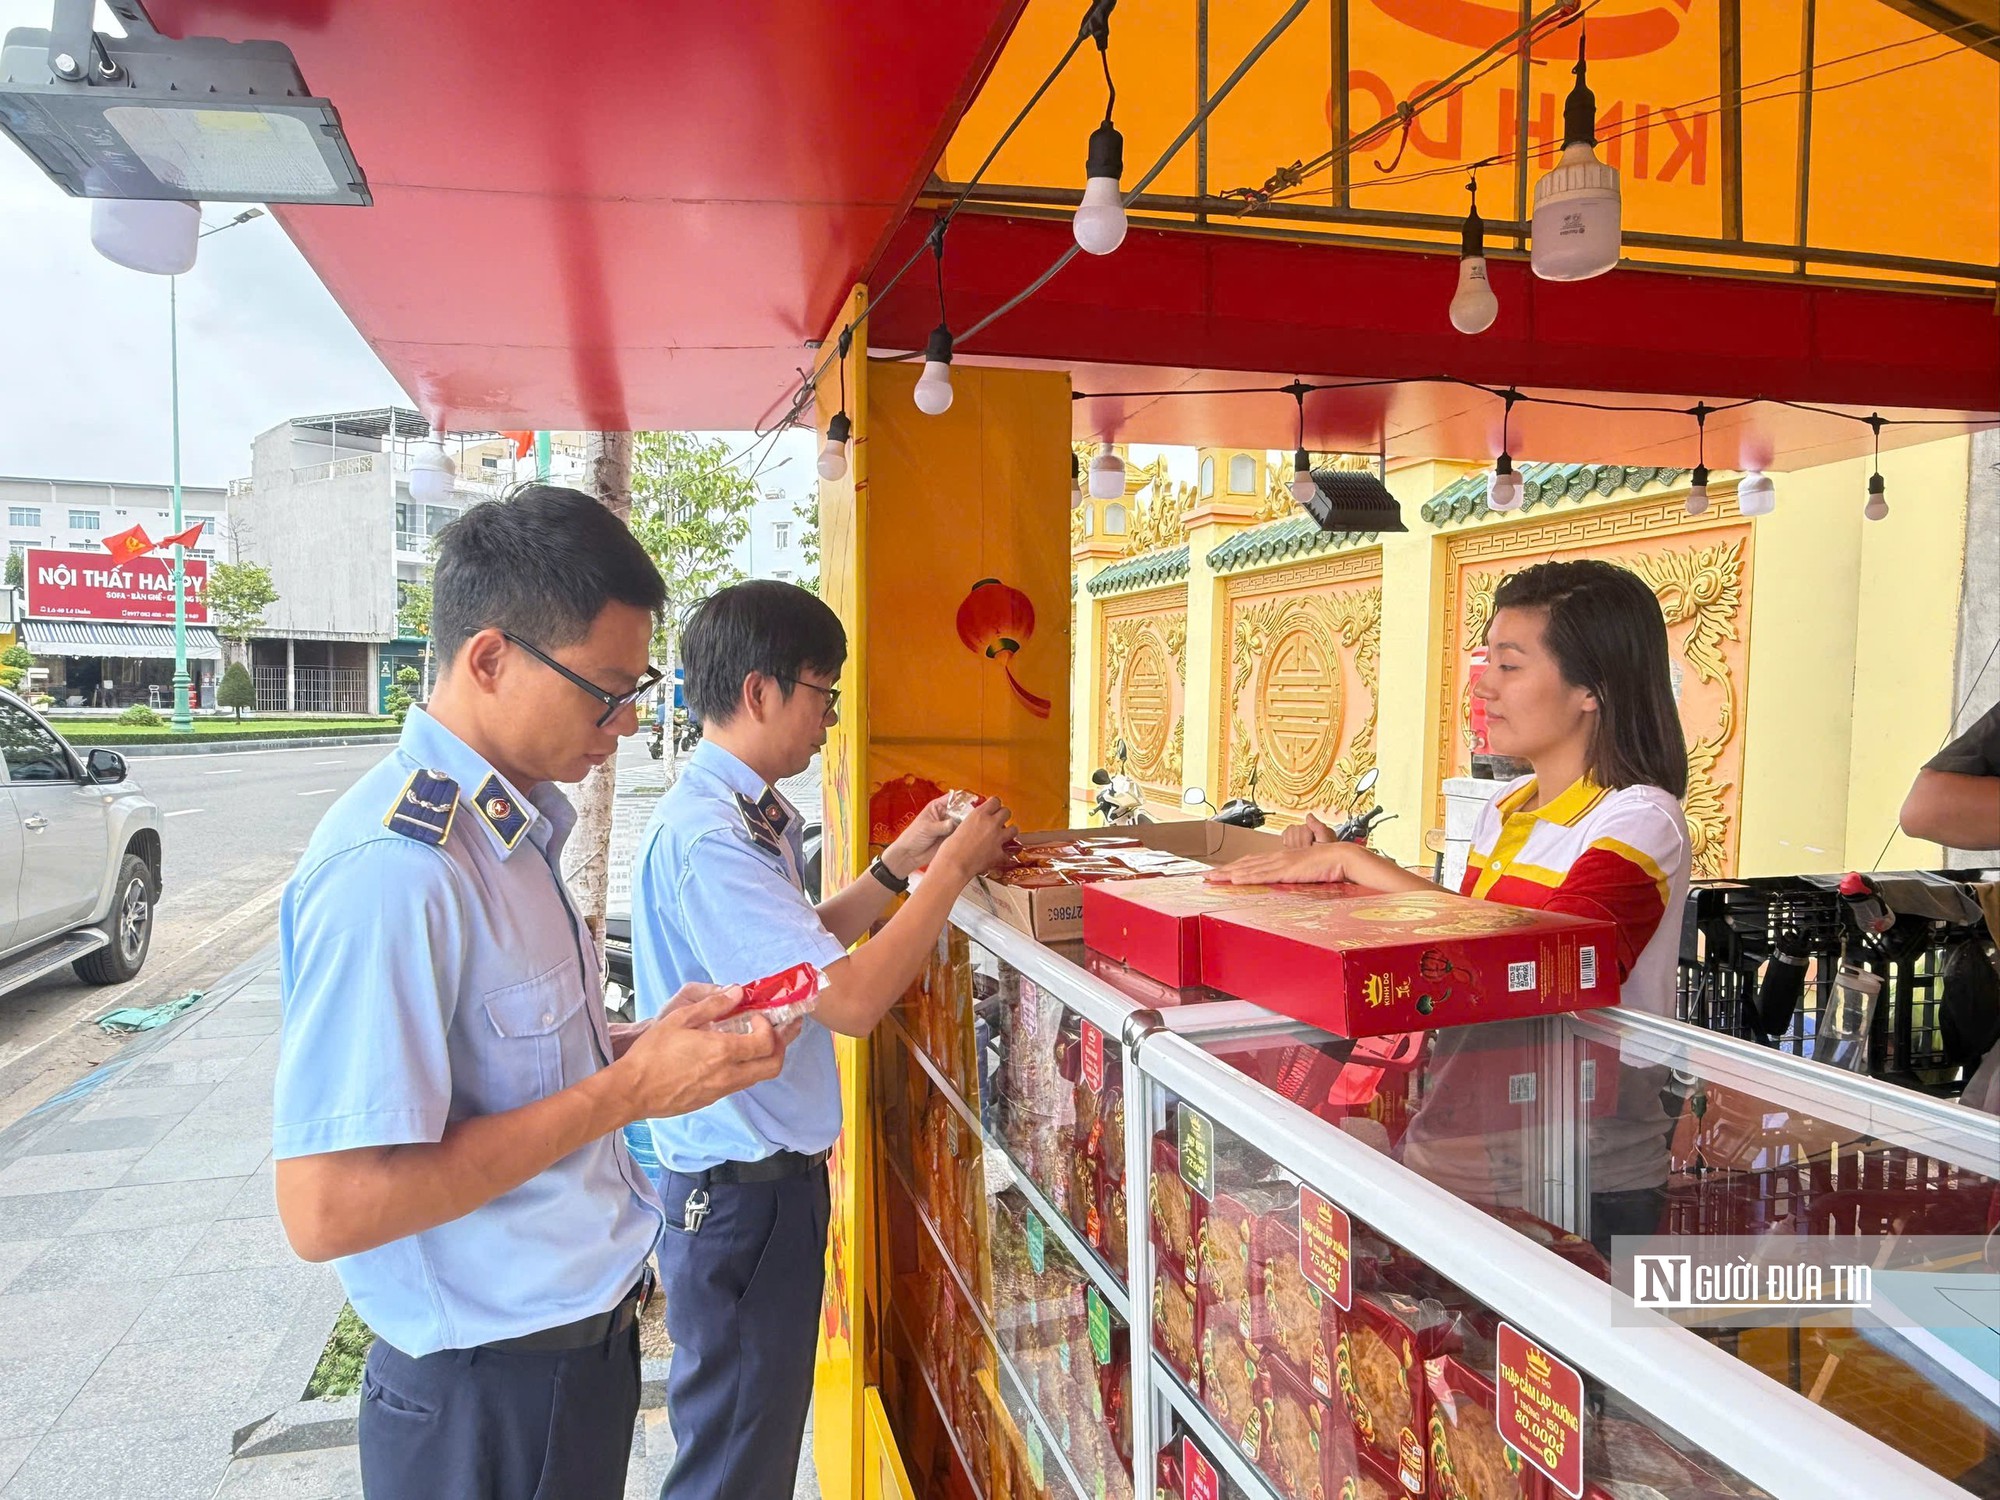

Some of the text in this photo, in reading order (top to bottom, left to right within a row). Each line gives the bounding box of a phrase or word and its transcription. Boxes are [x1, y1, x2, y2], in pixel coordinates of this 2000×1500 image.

[38, 563, 204, 593] NỘI THẤT HAPPY
[106, 591, 126, 600] SOFA
[1383, 972, 1391, 1006] KINH DO
[1501, 1363, 1579, 1433] THẬP CẢM LẠP XƯỞNG
[1513, 1390, 1518, 1405] 1
[1545, 1416, 1560, 1436] 150
[1515, 1409, 1565, 1457] 80.000đ
